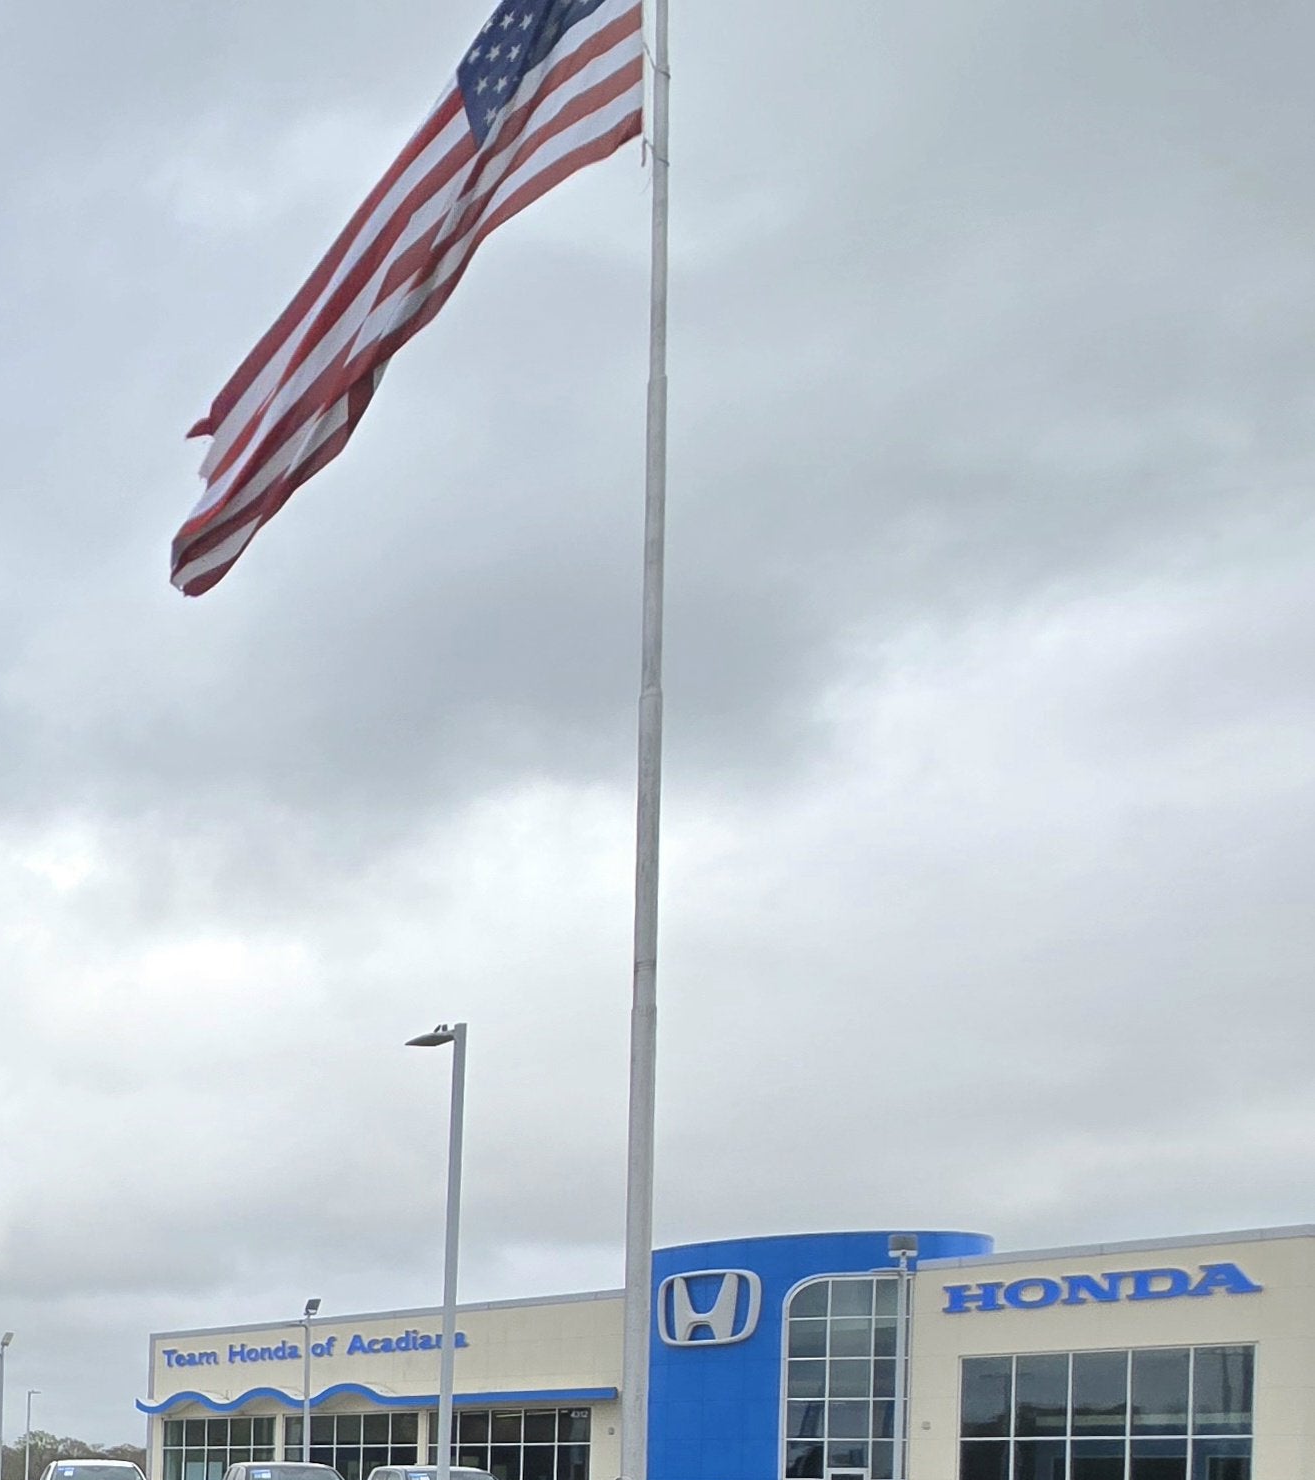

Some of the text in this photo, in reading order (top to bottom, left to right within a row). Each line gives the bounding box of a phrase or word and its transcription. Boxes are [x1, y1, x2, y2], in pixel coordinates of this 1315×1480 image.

[942, 1262, 1265, 1314] HONDA
[162, 1348, 220, 1368] Team
[227, 1340, 303, 1364] Honda
[310, 1335, 338, 1358] of
